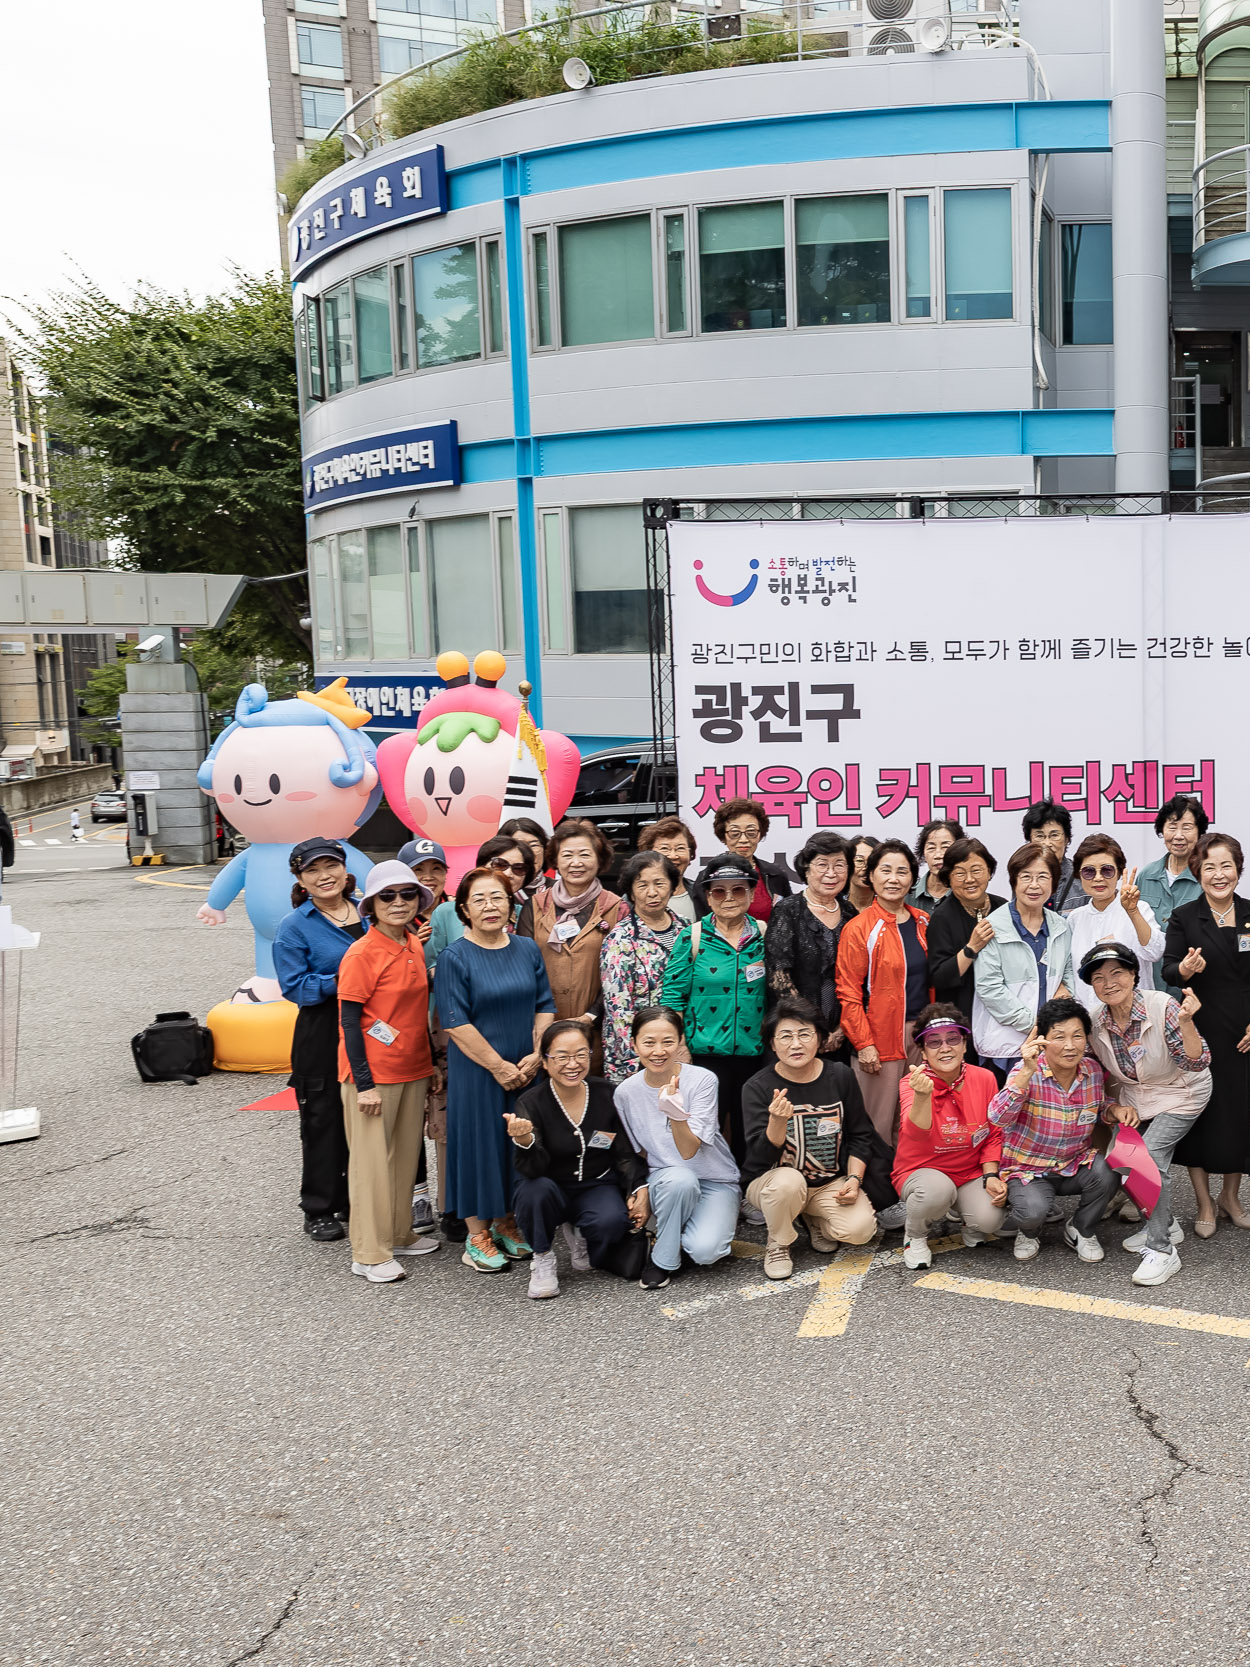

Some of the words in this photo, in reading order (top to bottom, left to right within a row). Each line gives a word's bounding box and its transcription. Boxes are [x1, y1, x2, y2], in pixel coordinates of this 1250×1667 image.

[300, 166, 423, 250] 광진구체육회
[767, 556, 810, 577] 소통하며
[811, 555, 857, 576] 발전하는
[767, 574, 857, 607] 행복광진
[690, 642, 801, 665] 광진구민의
[810, 640, 878, 663] 화합과
[885, 640, 934, 663] 소통,
[942, 639, 1010, 661] 모두가
[1018, 637, 1062, 661] 함께
[1070, 637, 1138, 660] 즐기는
[1146, 635, 1214, 659] 건강한
[691, 681, 861, 744] 광진구
[692, 763, 863, 829] 체육인
[875, 759, 1216, 829] 커뮤니티센터
[415, 839, 435, 854] G
